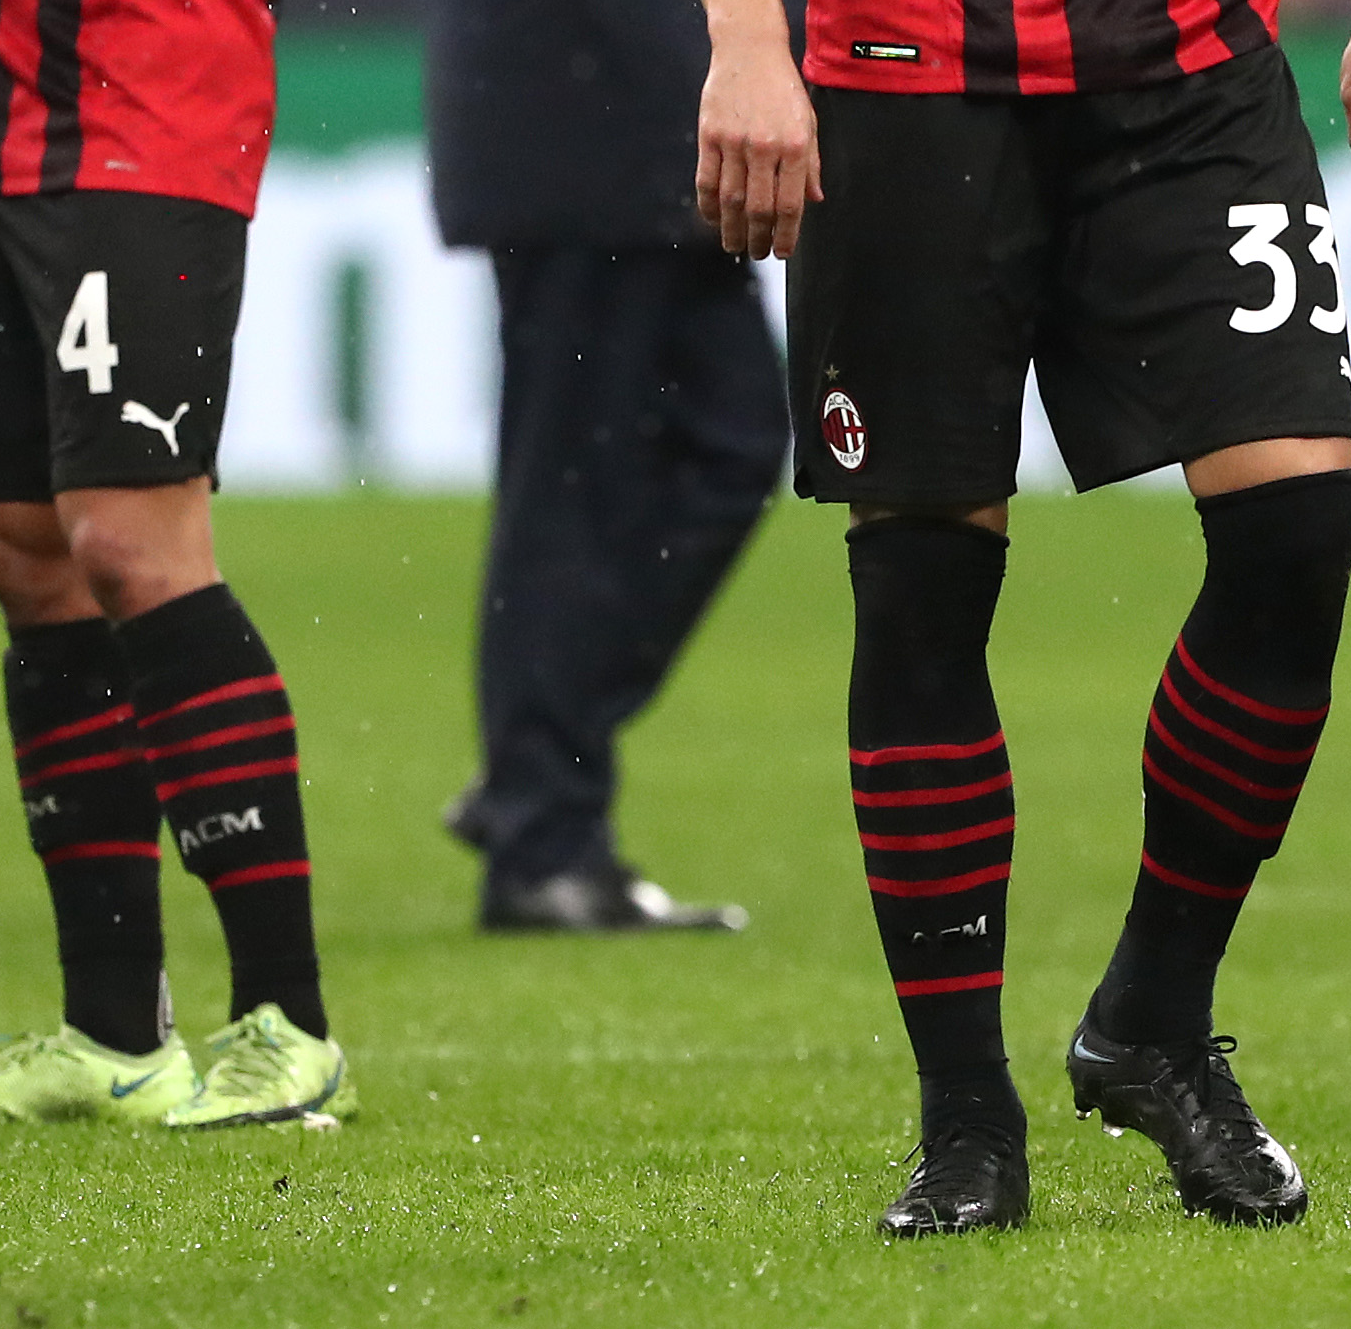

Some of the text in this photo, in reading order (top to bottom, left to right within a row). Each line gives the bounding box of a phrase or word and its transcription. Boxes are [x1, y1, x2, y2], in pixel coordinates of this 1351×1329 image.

[1227, 202, 1347, 335] 33
[56, 270, 119, 395] 4
[180, 806, 265, 857] ACM
